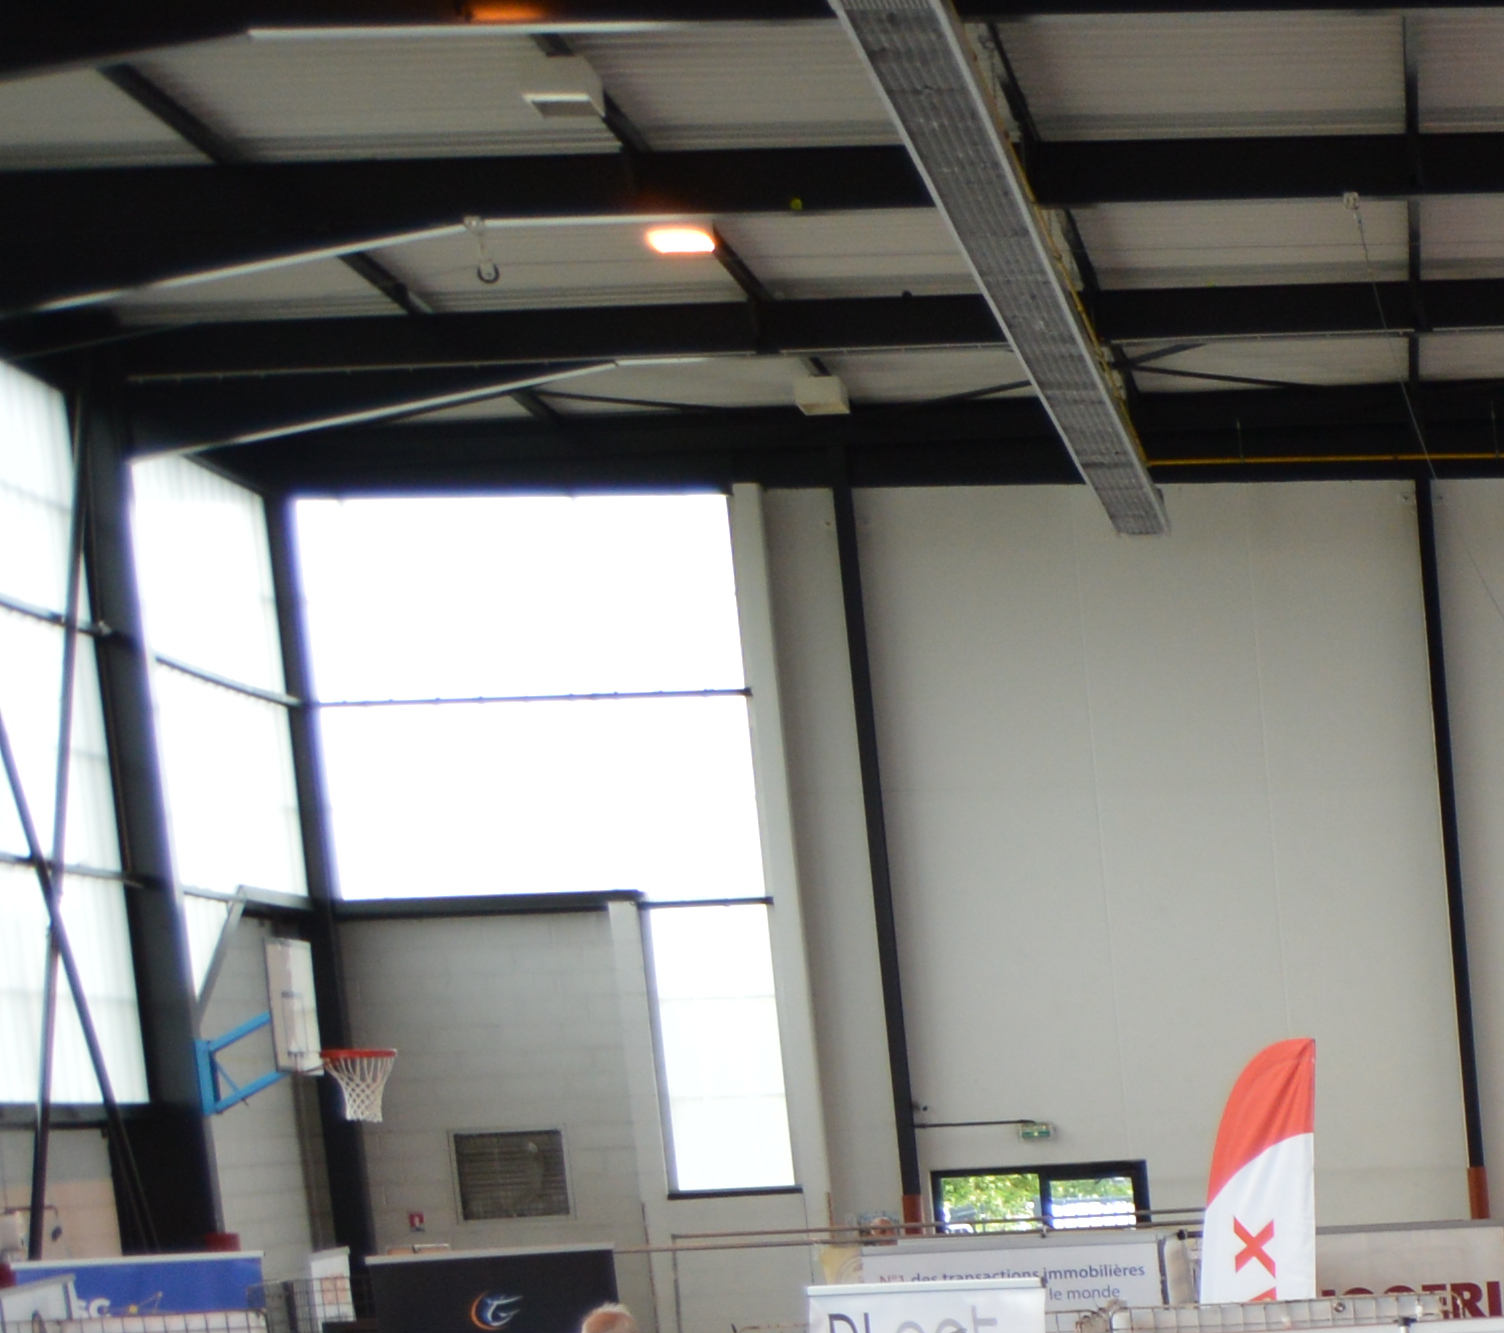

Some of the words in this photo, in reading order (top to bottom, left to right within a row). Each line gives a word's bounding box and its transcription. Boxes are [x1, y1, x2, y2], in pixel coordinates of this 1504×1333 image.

[1043, 1264, 1146, 1281] immobilières
[1049, 1288, 1063, 1300] le
[1066, 1285, 1121, 1300] monde
